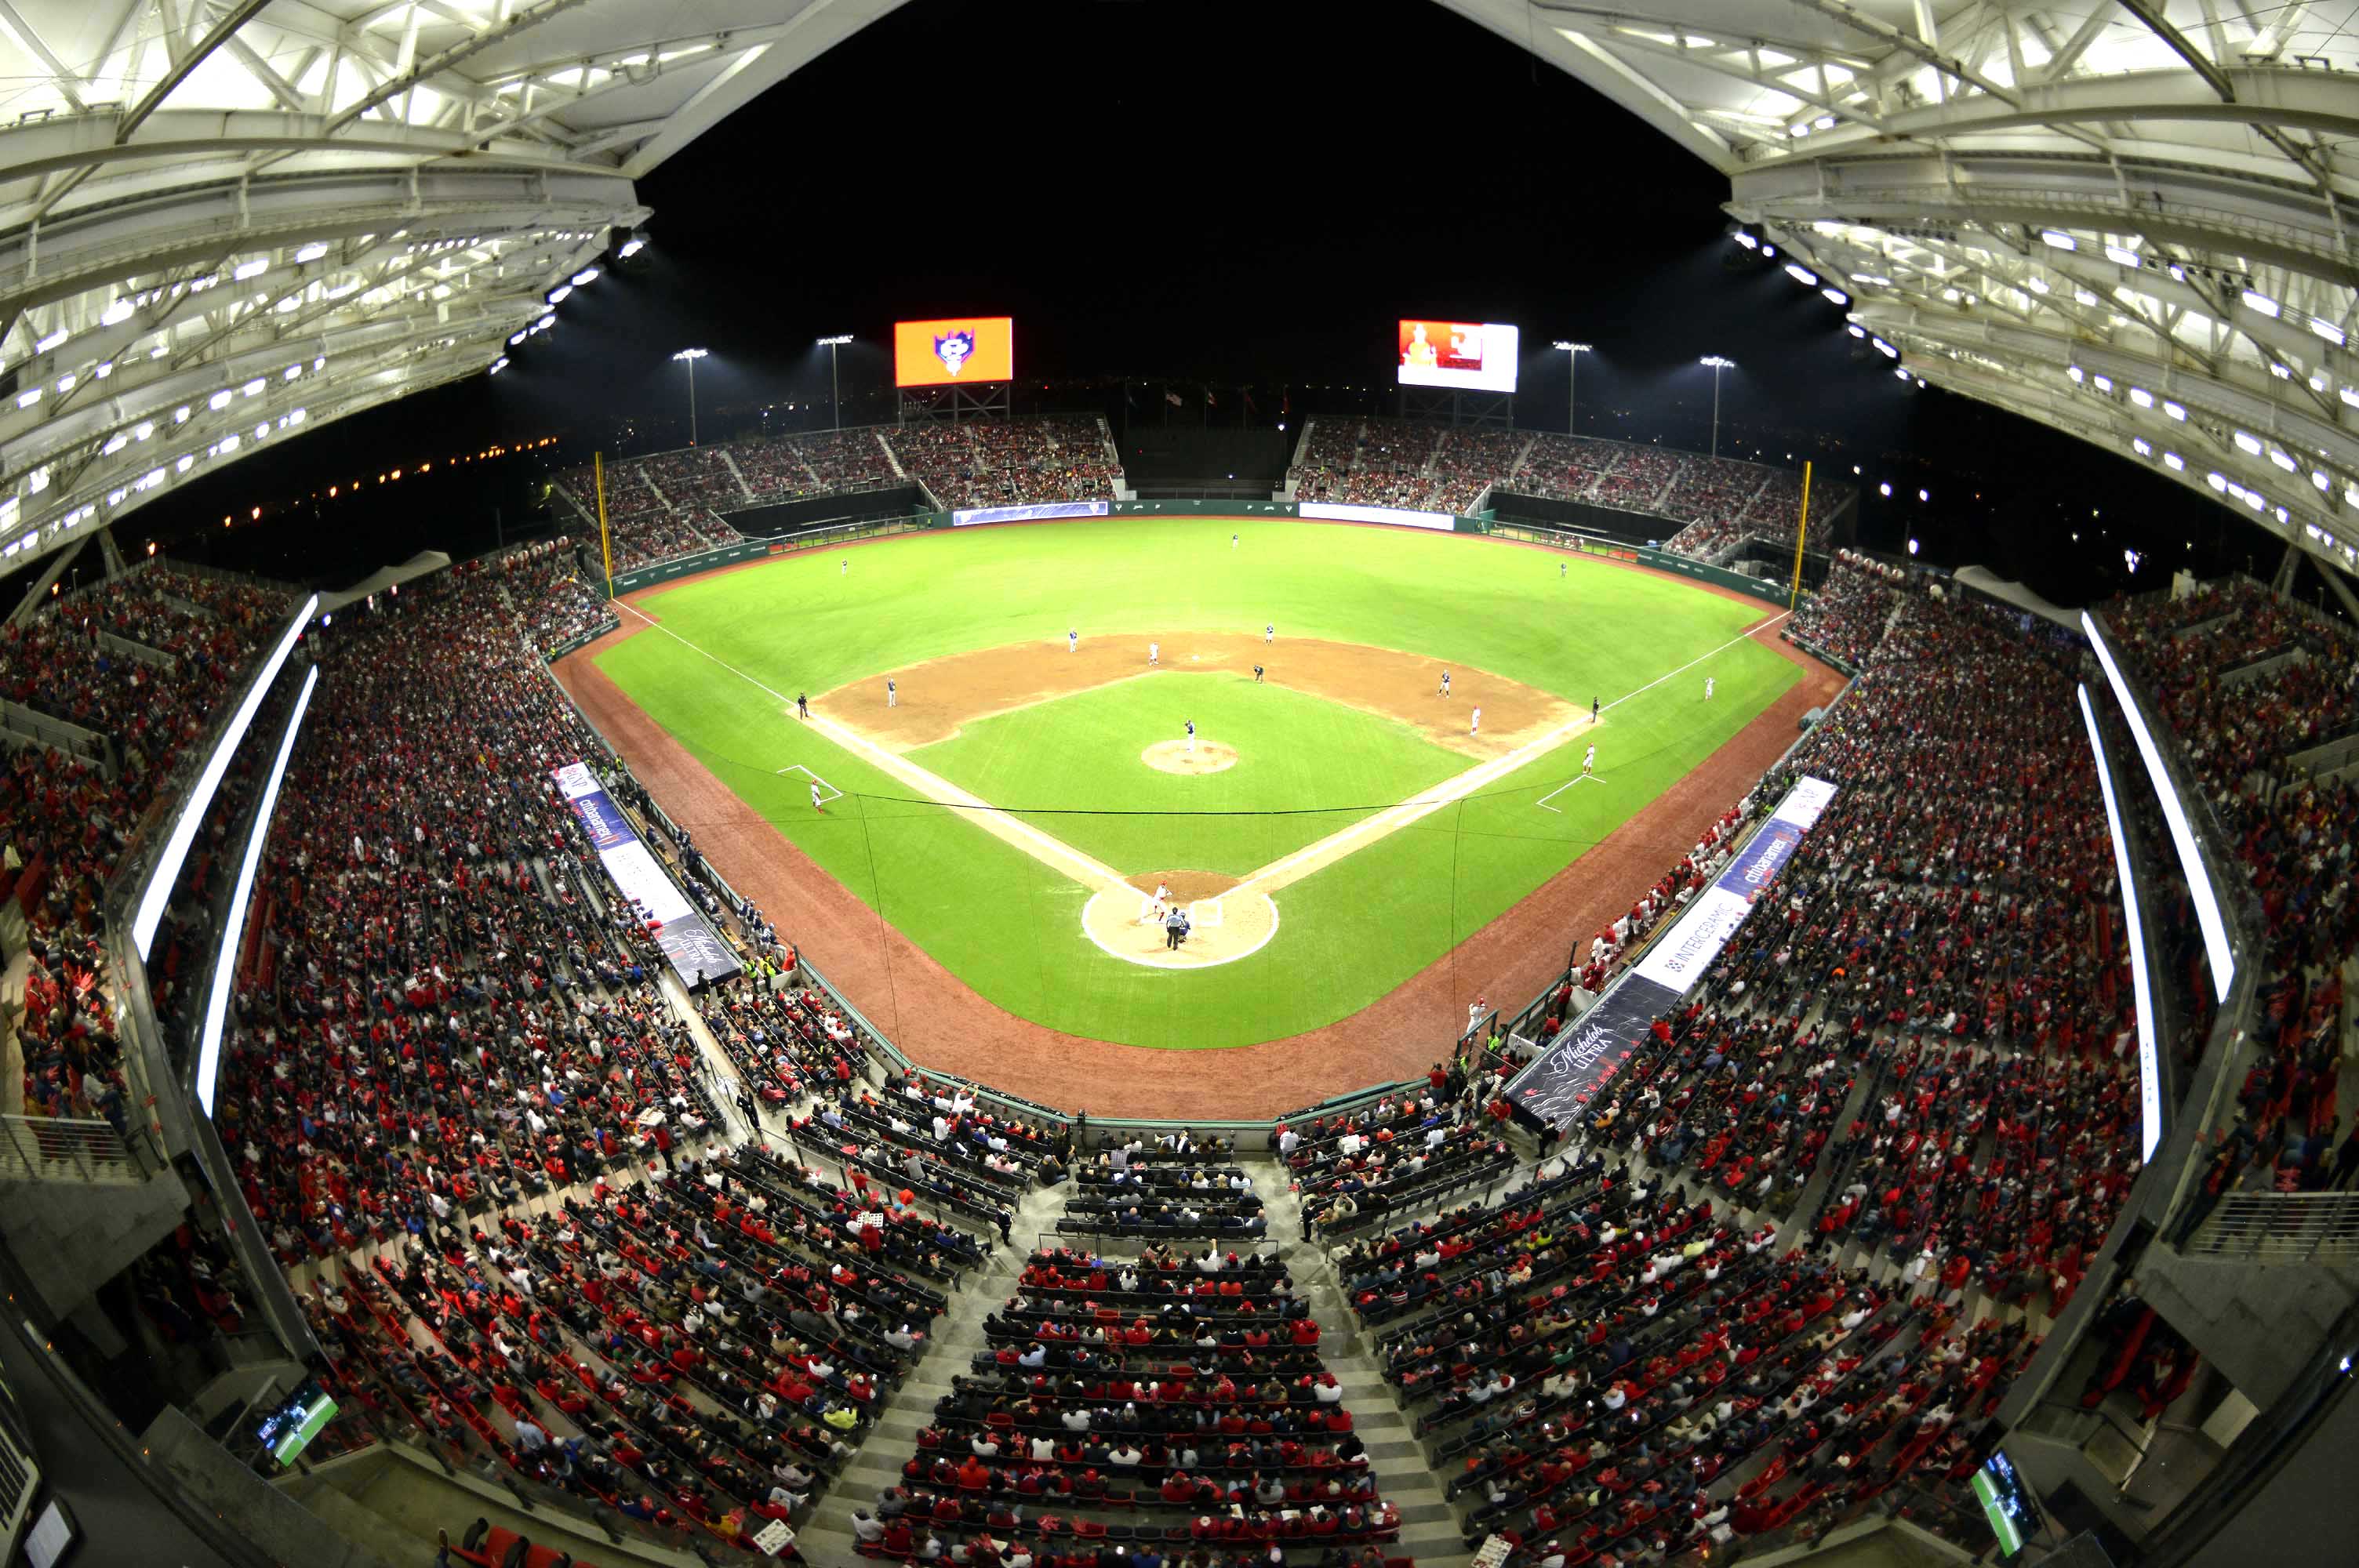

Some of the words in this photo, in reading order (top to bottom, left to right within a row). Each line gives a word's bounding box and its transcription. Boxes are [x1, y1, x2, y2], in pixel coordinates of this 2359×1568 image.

[580, 799, 612, 837] citibanamex
[1745, 838, 1787, 883] citibanamex
[680, 938, 703, 964] ULTRA
[685, 929, 724, 964] Michelob
[1675, 903, 1732, 963] INTERCERAMIC
[1550, 1023, 1604, 1073] Michelob
[1574, 1039, 1612, 1069] ULTRA
